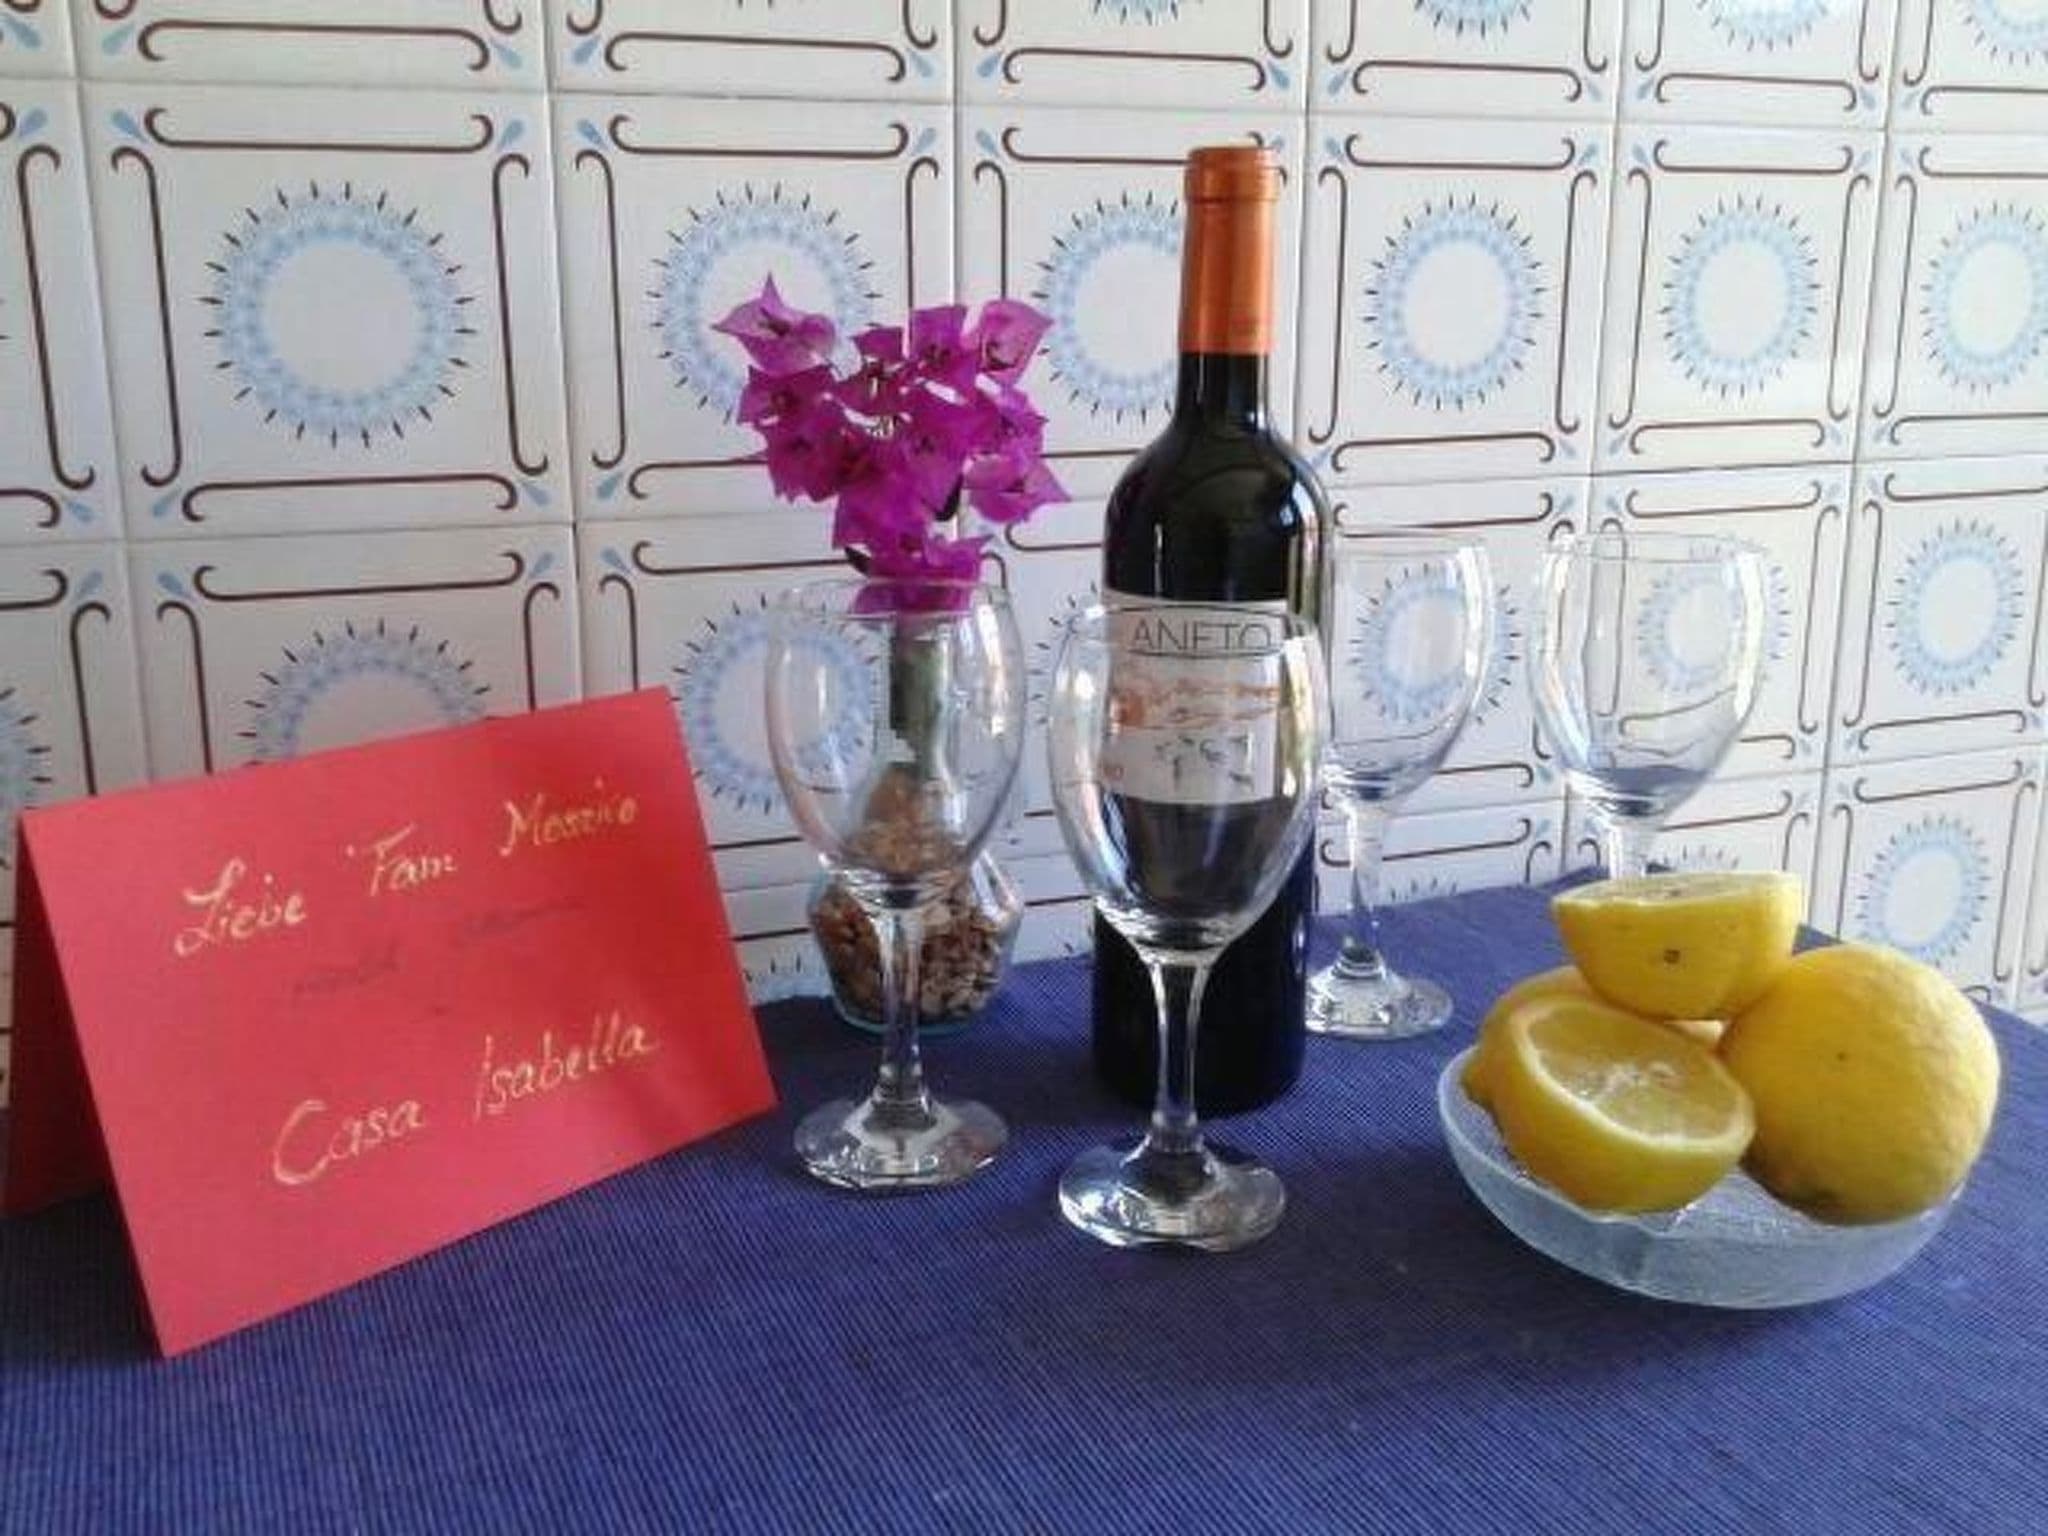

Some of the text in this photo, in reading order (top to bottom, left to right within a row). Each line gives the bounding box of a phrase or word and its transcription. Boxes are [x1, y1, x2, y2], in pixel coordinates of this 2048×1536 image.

[1132, 617, 1273, 651] ANETO
[174, 856, 307, 958] Liebe
[272, 1008, 658, 1185] Casa Isabella
